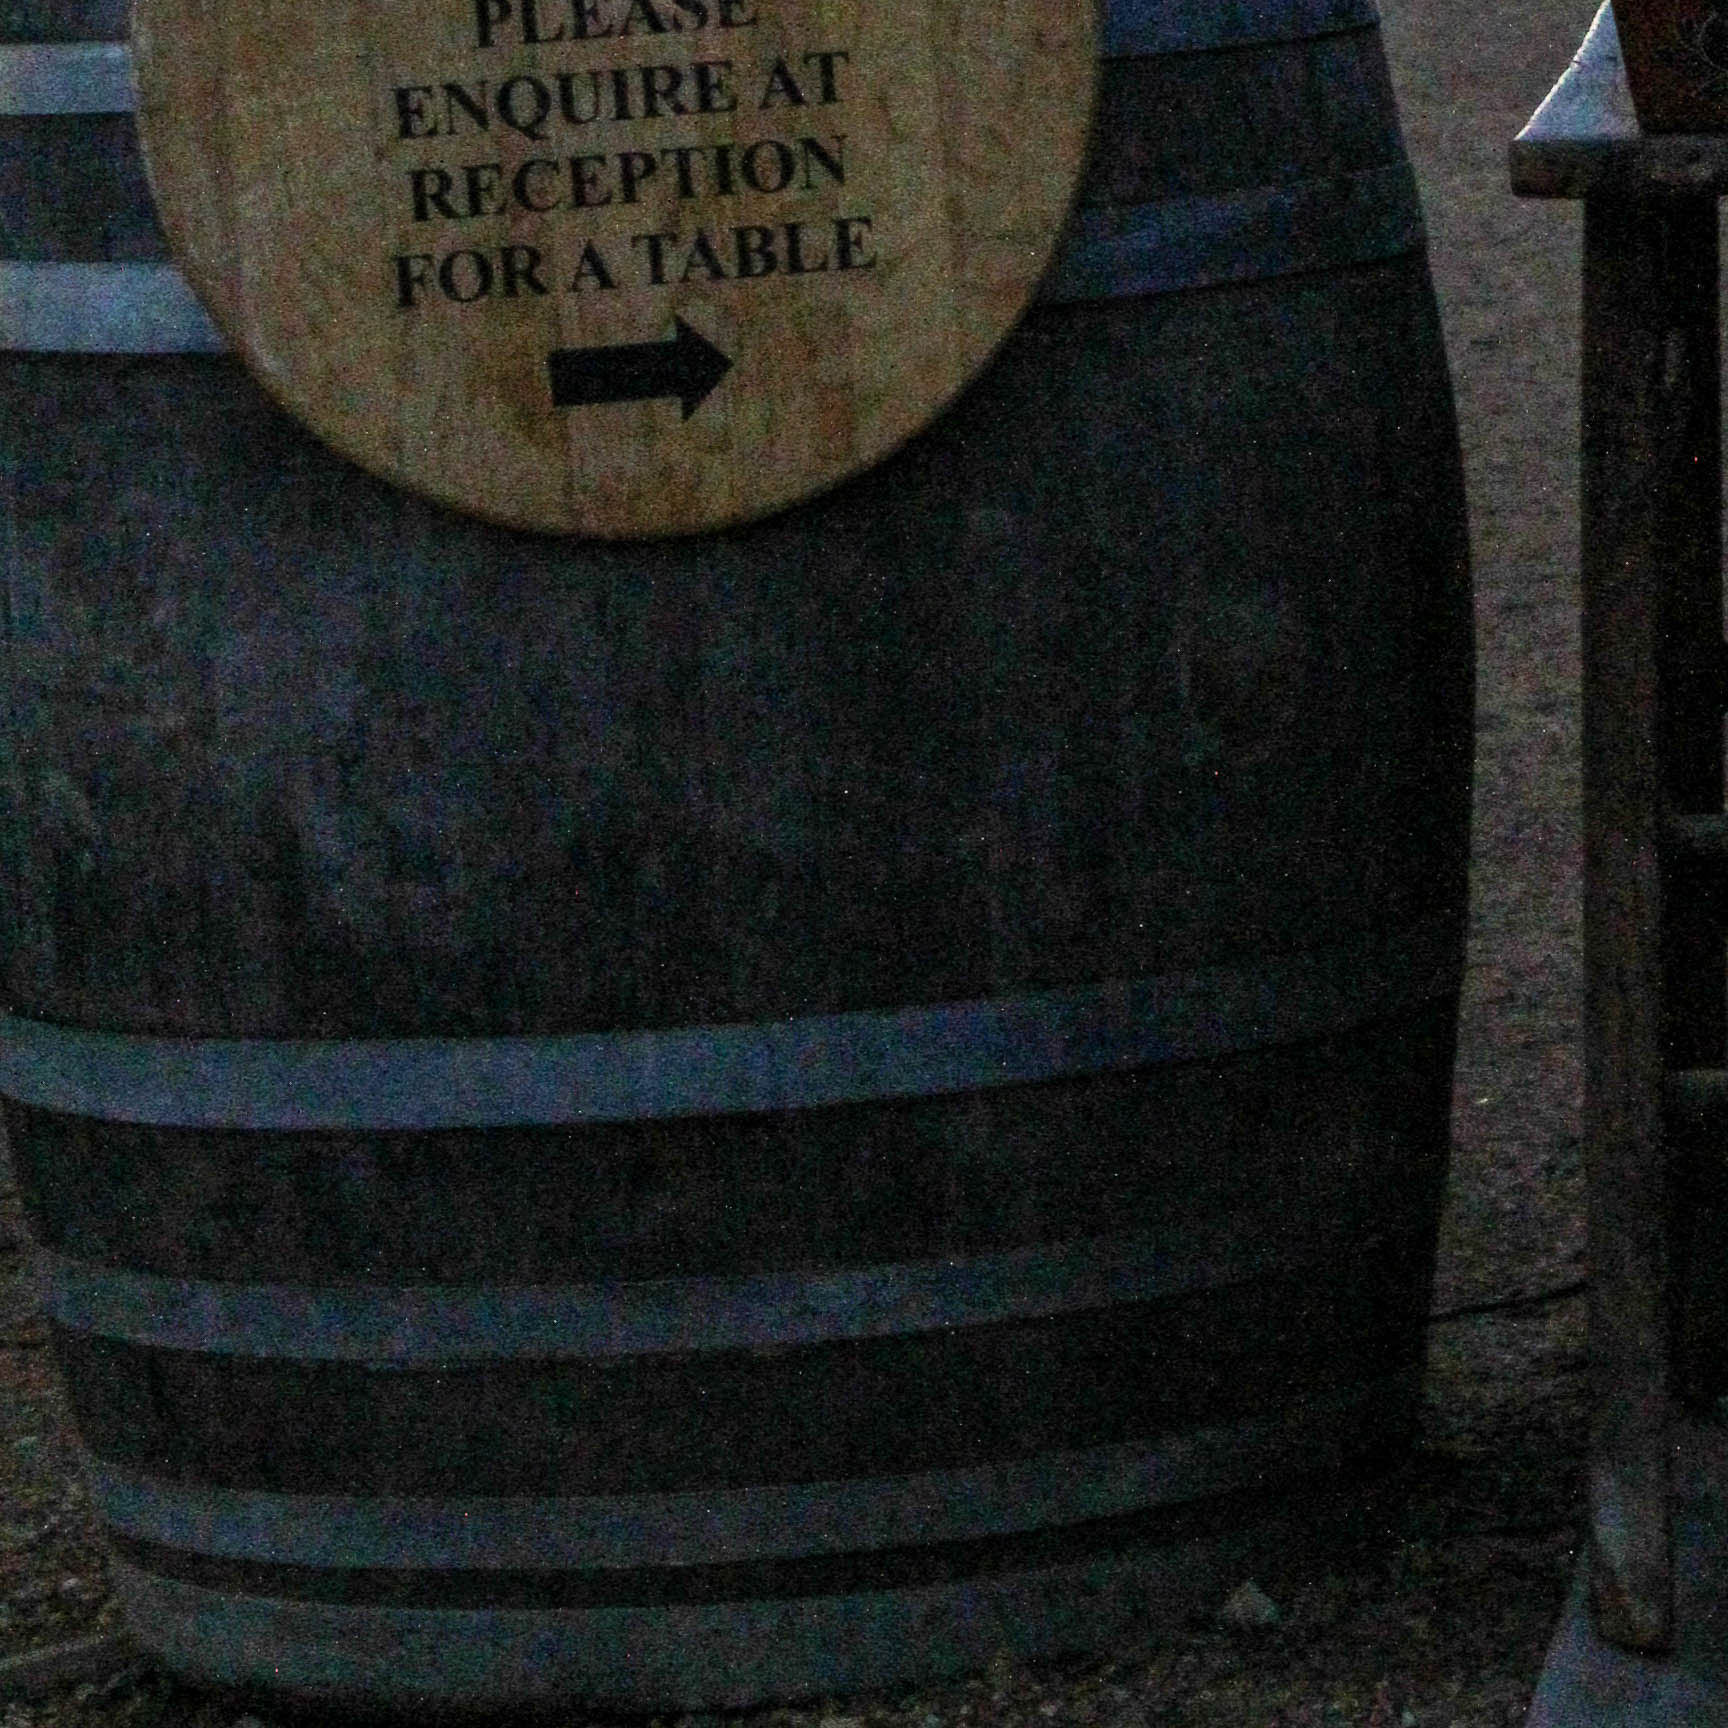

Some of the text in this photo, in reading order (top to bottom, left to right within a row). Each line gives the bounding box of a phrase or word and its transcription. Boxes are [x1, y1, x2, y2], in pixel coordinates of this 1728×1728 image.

[393, 50, 849, 141] ENQUIRE AT
[407, 133, 848, 223] RECEPTION
[393, 216, 878, 308] FOR A TABLE
